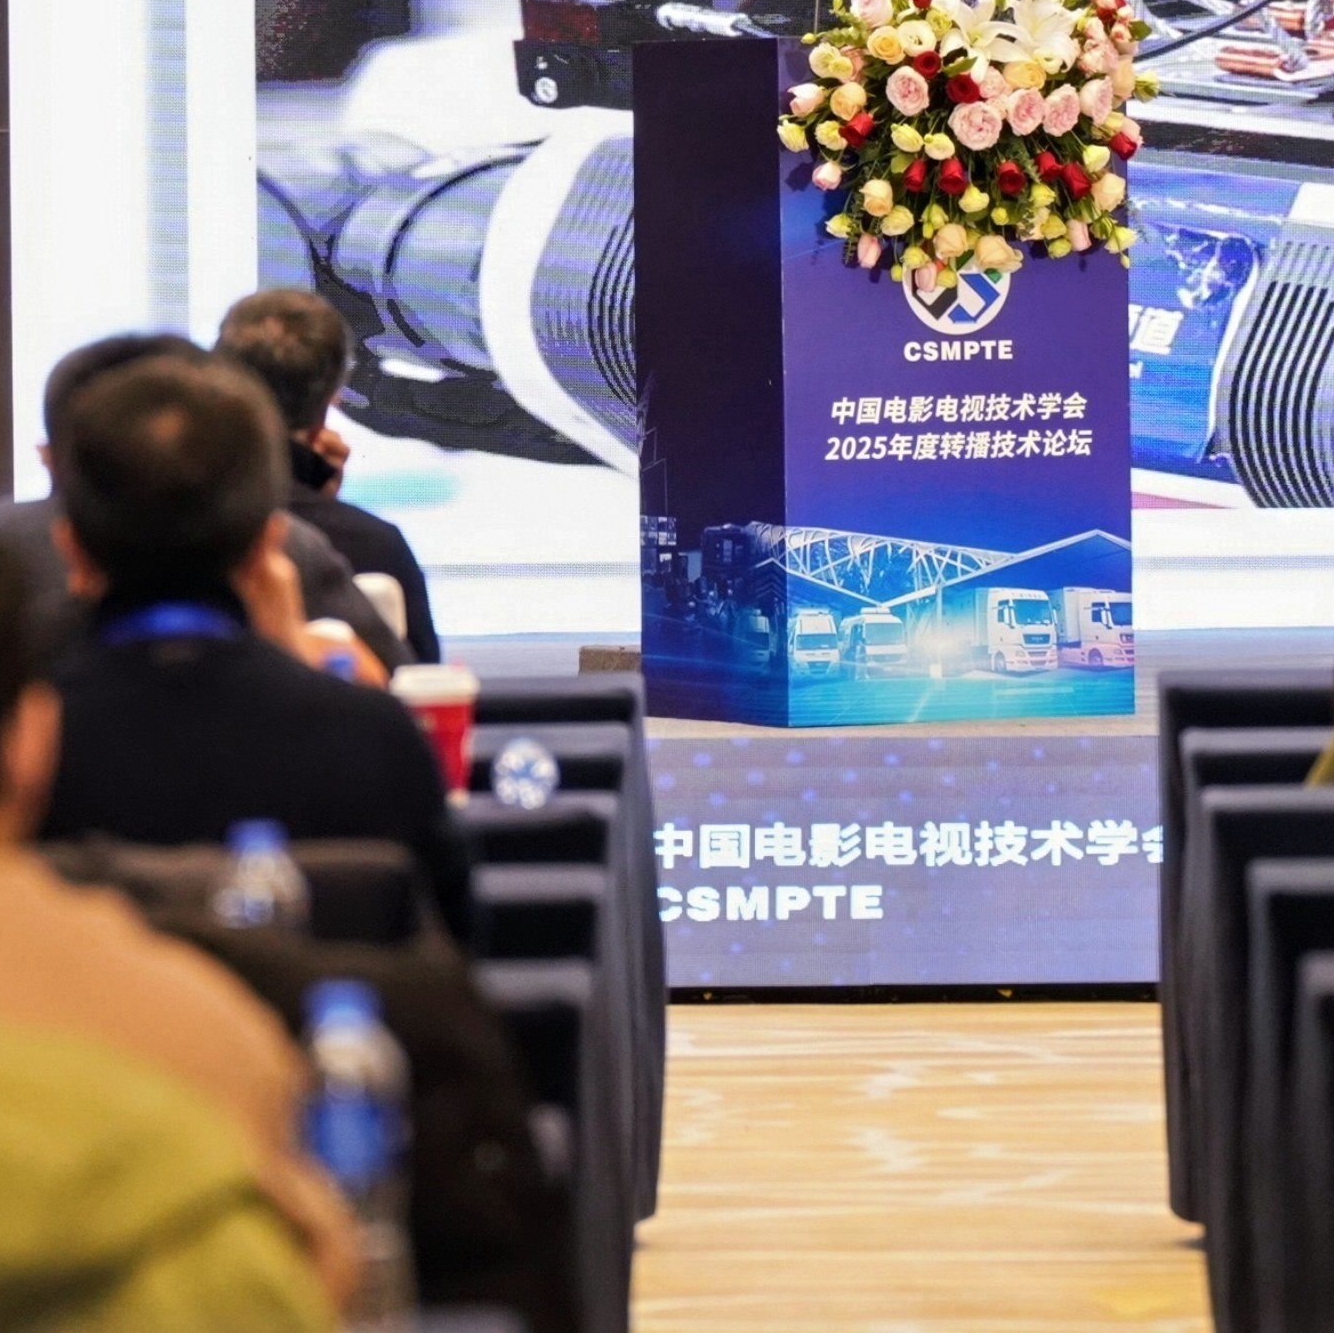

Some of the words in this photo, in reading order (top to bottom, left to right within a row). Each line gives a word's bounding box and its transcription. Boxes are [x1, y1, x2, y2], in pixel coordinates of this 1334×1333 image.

[903, 340, 1013, 362] CSMPTE
[830, 392, 1088, 426] 中国电影电视技术学会
[824, 428, 1093, 461] 2025年度转播技术论坛
[657, 885, 884, 922] CSMPTE
